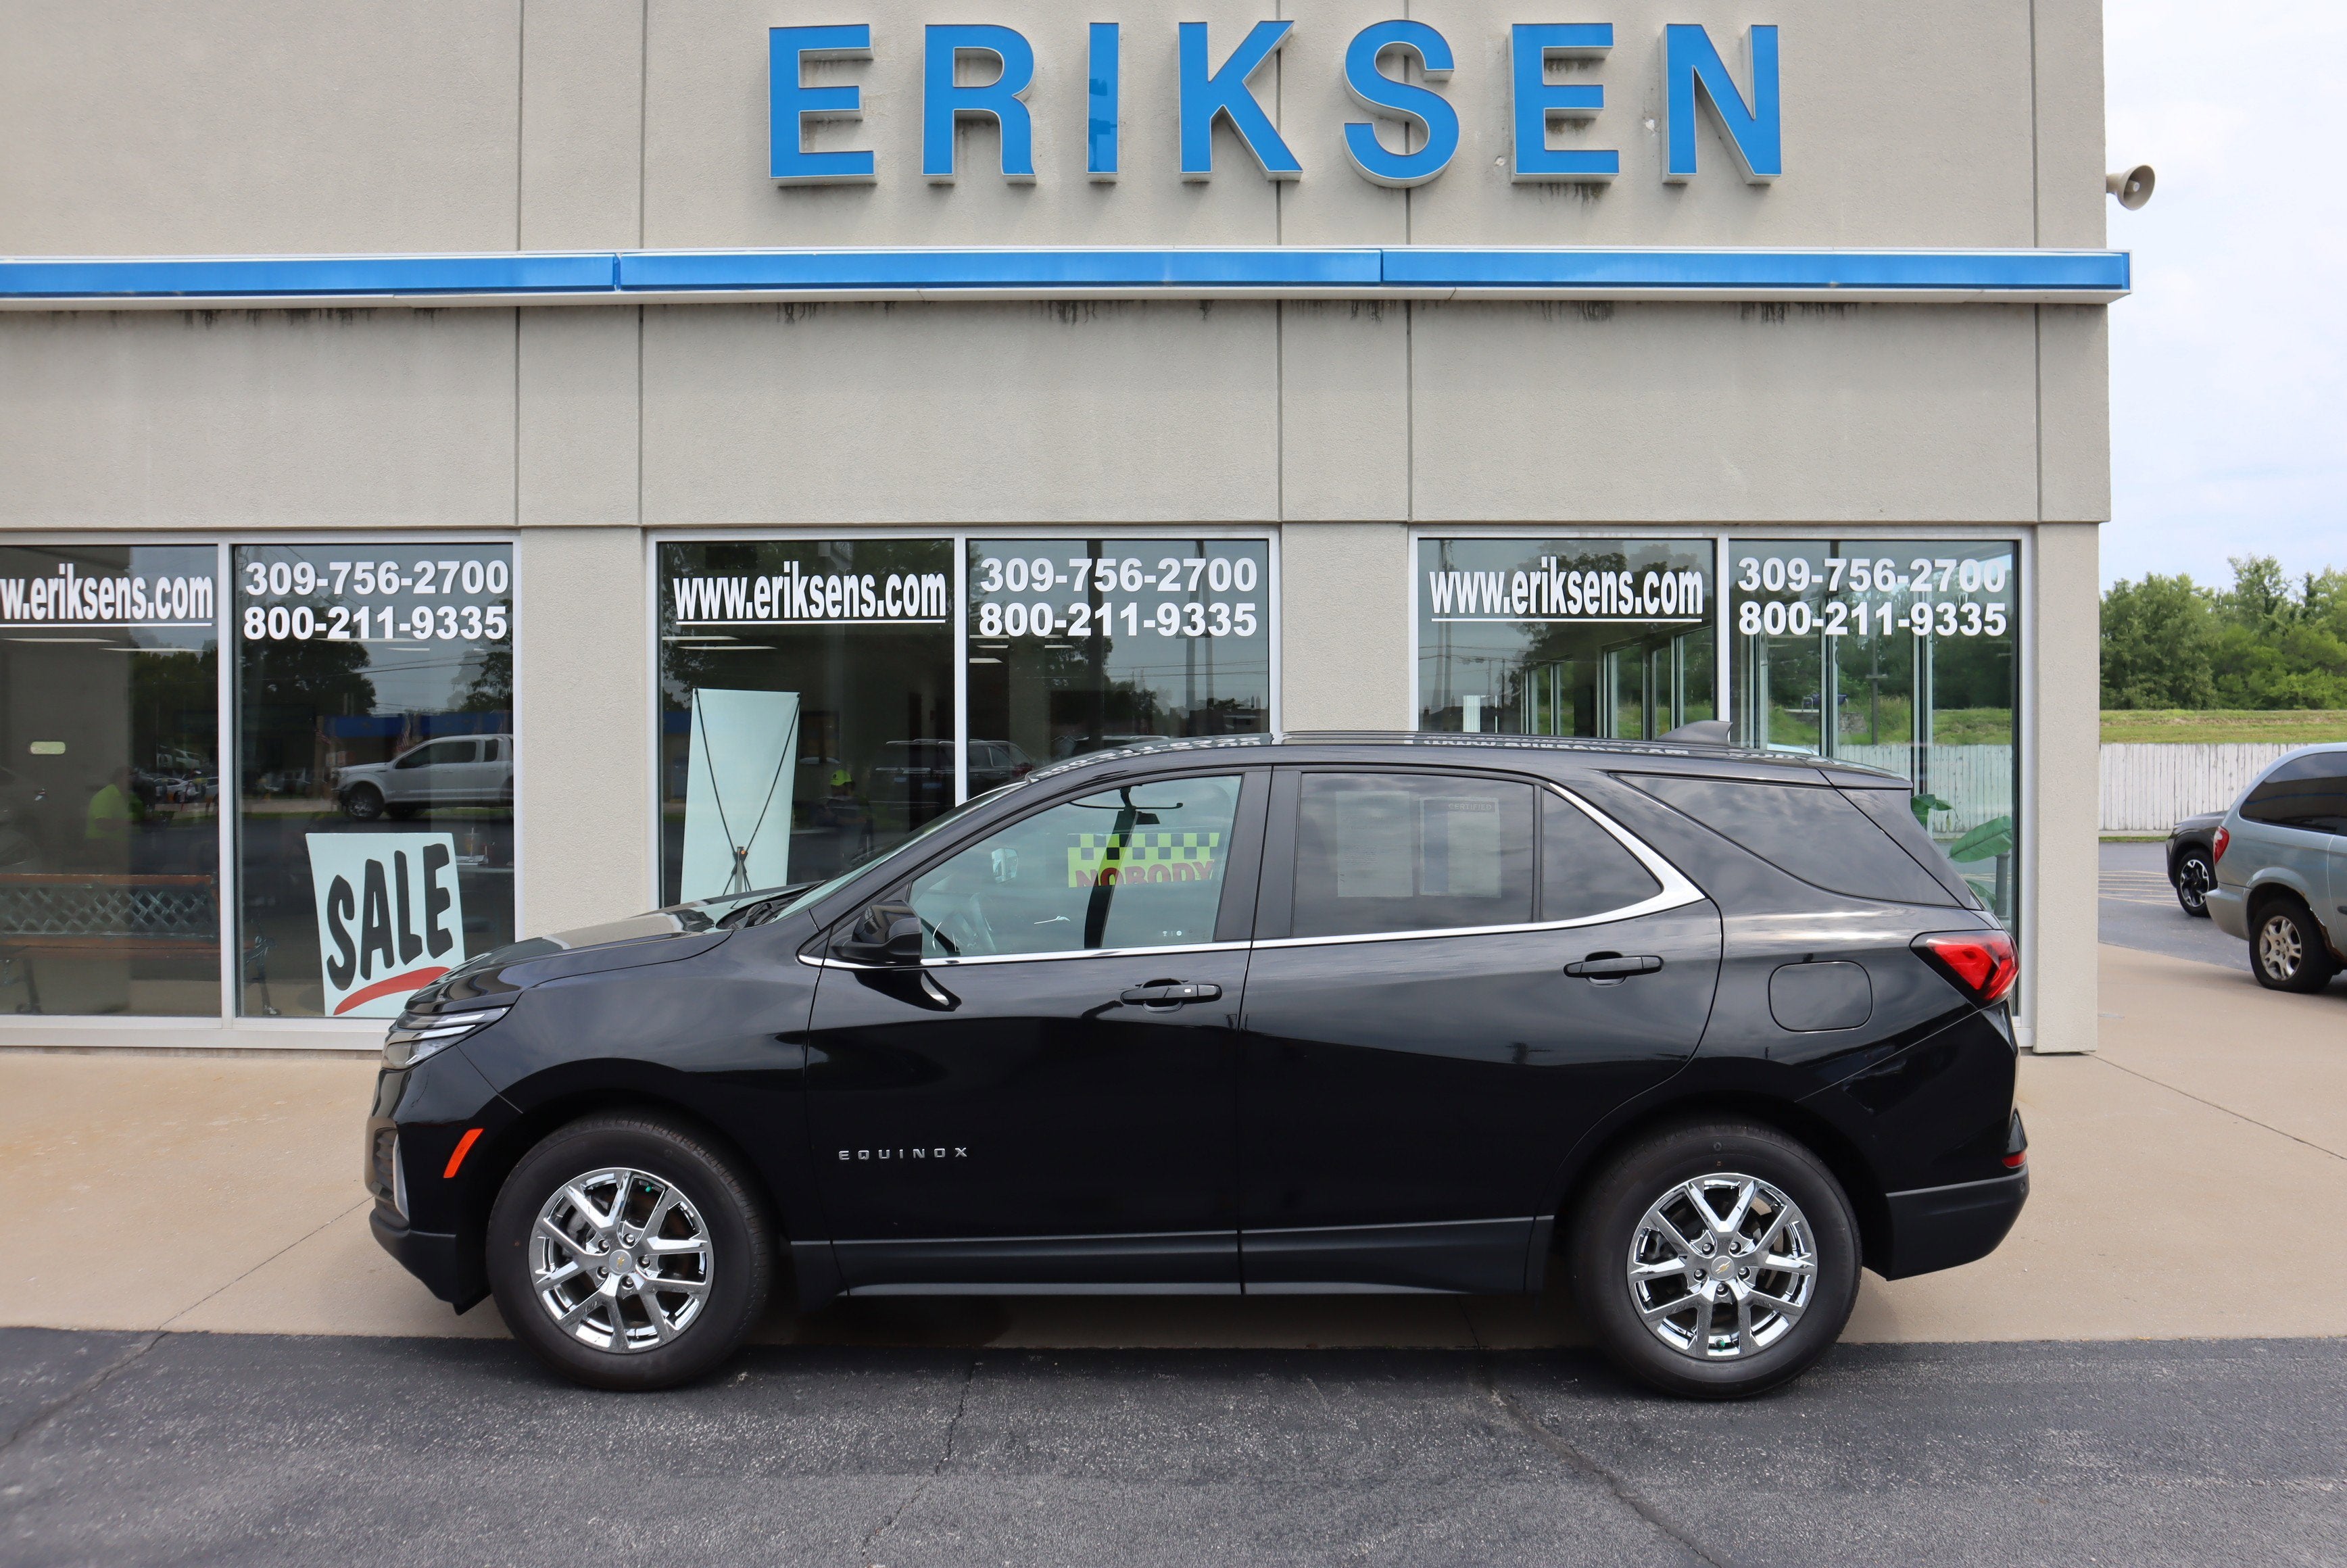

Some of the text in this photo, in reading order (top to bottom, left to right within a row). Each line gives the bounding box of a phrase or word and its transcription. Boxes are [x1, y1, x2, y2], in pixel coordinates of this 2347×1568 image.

[769, 20, 1783, 182] ERIKSEN
[245, 560, 509, 596] 309-756-2700
[673, 560, 946, 620] www.eriksens.com
[980, 558, 1257, 592] 309-756-2700
[1428, 556, 1703, 615] www.eriksens.com
[1738, 557, 2007, 593] 309-756-2700
[243, 605, 508, 640] 800-211-9335
[979, 602, 1257, 637] 800-211-9335
[1739, 600, 2007, 637] 800-211-9335
[326, 843, 454, 991] SALE
[838, 1148, 967, 1160] EQUINOX
